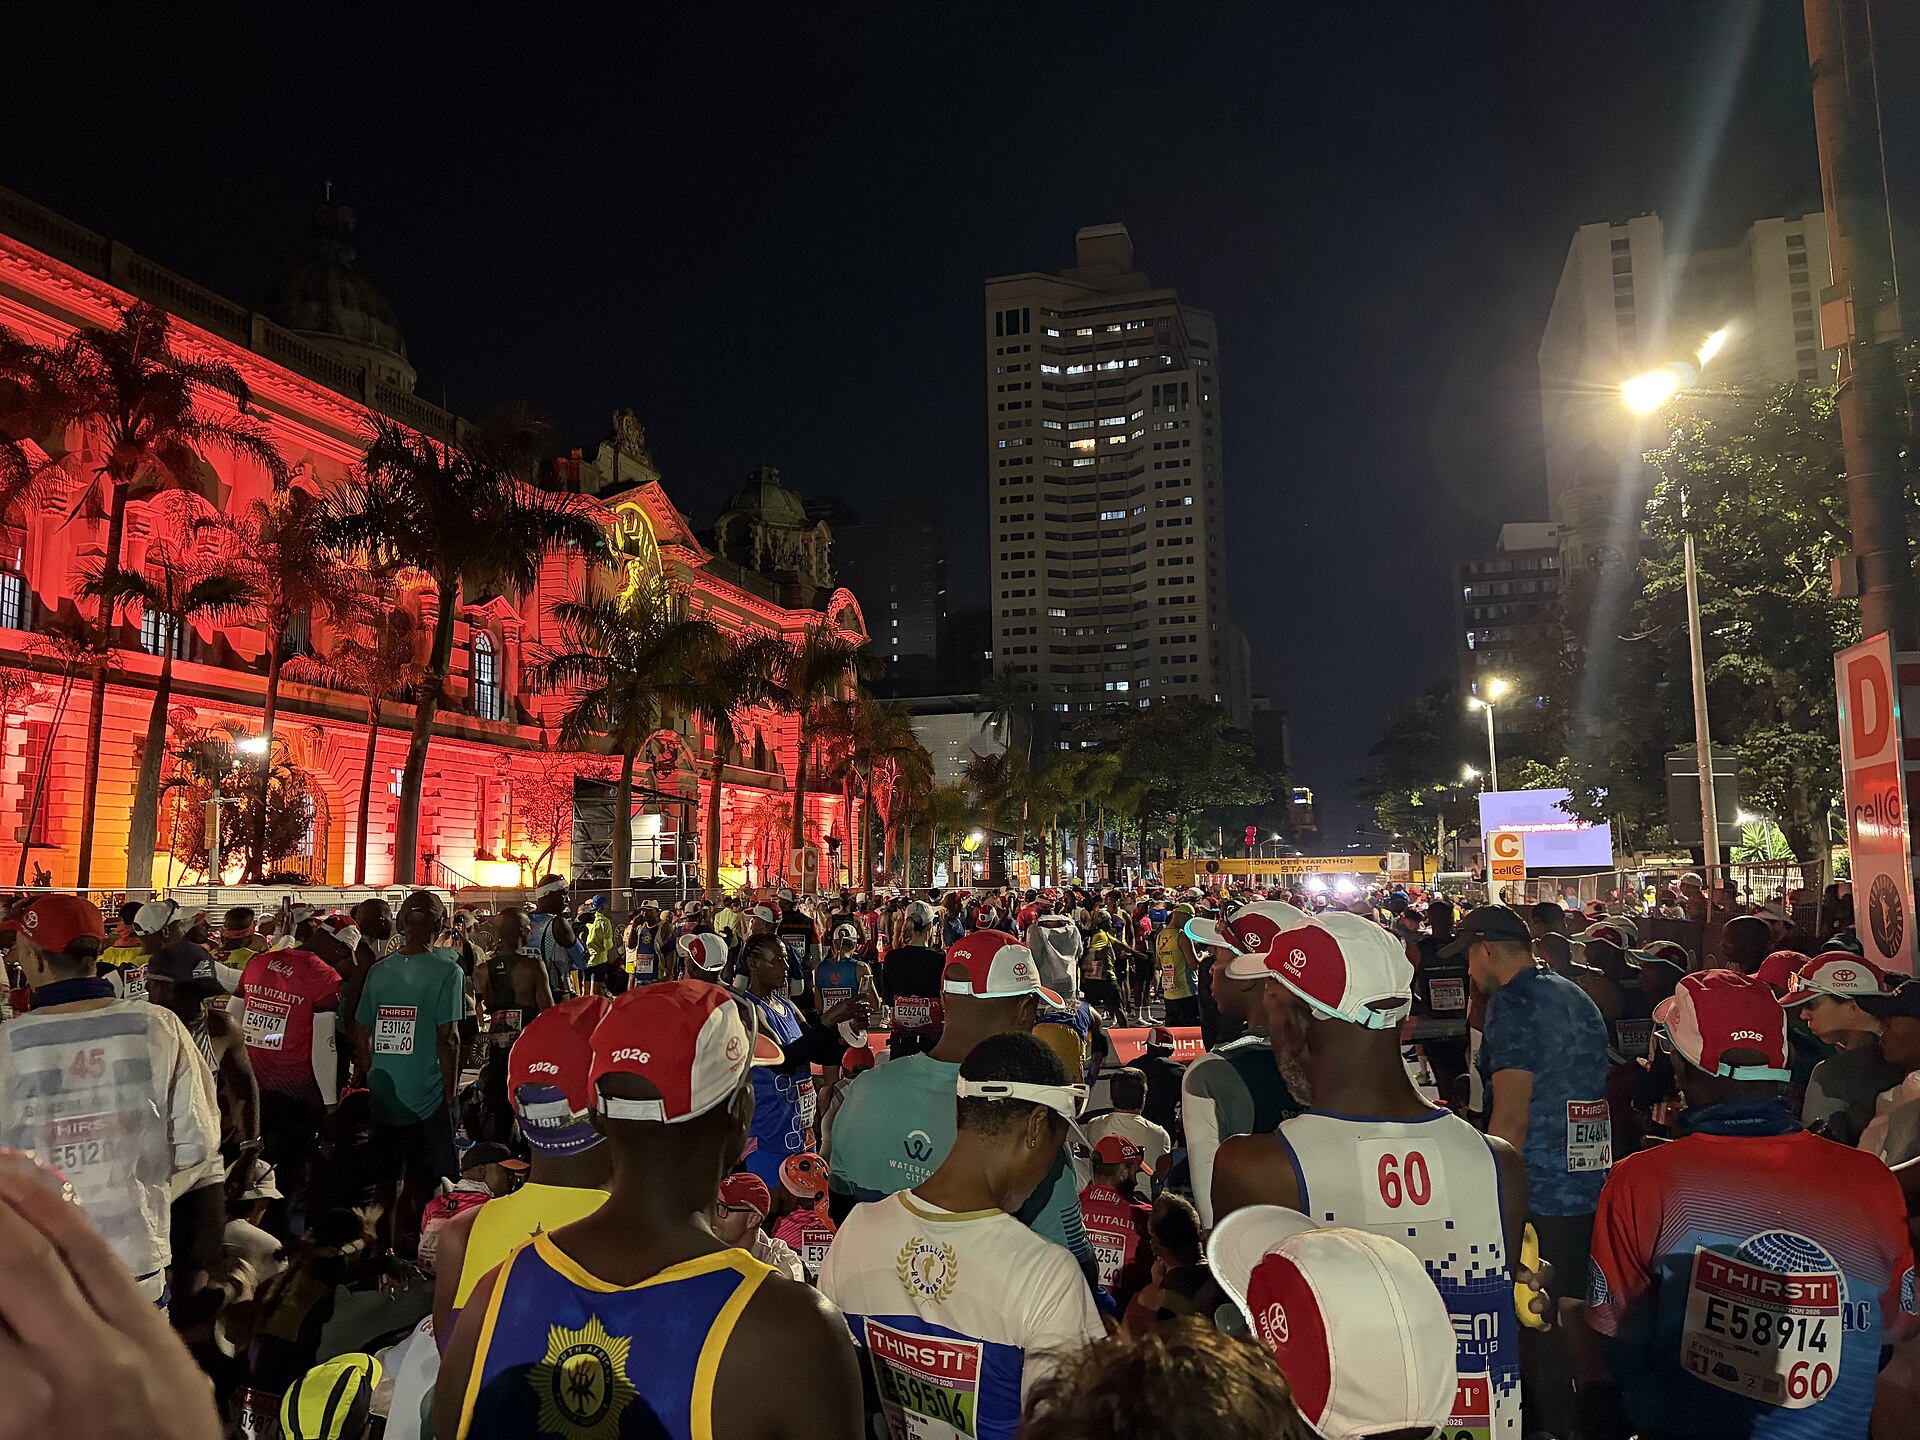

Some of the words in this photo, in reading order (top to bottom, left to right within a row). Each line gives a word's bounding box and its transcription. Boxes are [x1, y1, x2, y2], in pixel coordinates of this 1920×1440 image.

[1847, 654, 1890, 760] D
[1494, 834, 1519, 858] C
[805, 850, 815, 872] C
[1281, 865, 1321, 873] START
[953, 949, 972, 960] 2026
[267, 960, 294, 978] Vitality
[1283, 961, 1302, 978] TOYOTA
[264, 987, 305, 1006] VITALITY
[379, 1008, 414, 1016] THIRSTI
[897, 1006, 927, 1017] E26240
[246, 1012, 282, 1031] E49147
[381, 1020, 411, 1034] E31162
[399, 1036, 412, 1051] 60
[1622, 1031, 1650, 1044] E3562
[1730, 1030, 1763, 1042] 2026
[69, 1048, 105, 1079] 45
[611, 1048, 651, 1064] 2026
[528, 1061, 560, 1075] 2026
[889, 1160, 934, 1177] WATERFA
[905, 1172, 926, 1183] CITY
[1377, 1151, 1432, 1210] 60
[1089, 1188, 1121, 1206] Vitality
[1093, 1214, 1136, 1230] VITALIT
[806, 1233, 834, 1241] THIR
[1086, 1234, 1121, 1245] HIRSTI
[914, 1245, 946, 1262] CHILLIE
[1093, 1249, 1119, 1266] 254
[1103, 1268, 1121, 1284] 40
[1707, 1261, 1829, 1300] THIRSTI
[1259, 1309, 1277, 1353] TOYOTA
[1705, 1296, 1828, 1353] E58914
[873, 1330, 963, 1371] THIRSTI
[939, 1378, 954, 1388] 2026
[1787, 1360, 1833, 1399] 60
[882, 1365, 967, 1431] E59506
